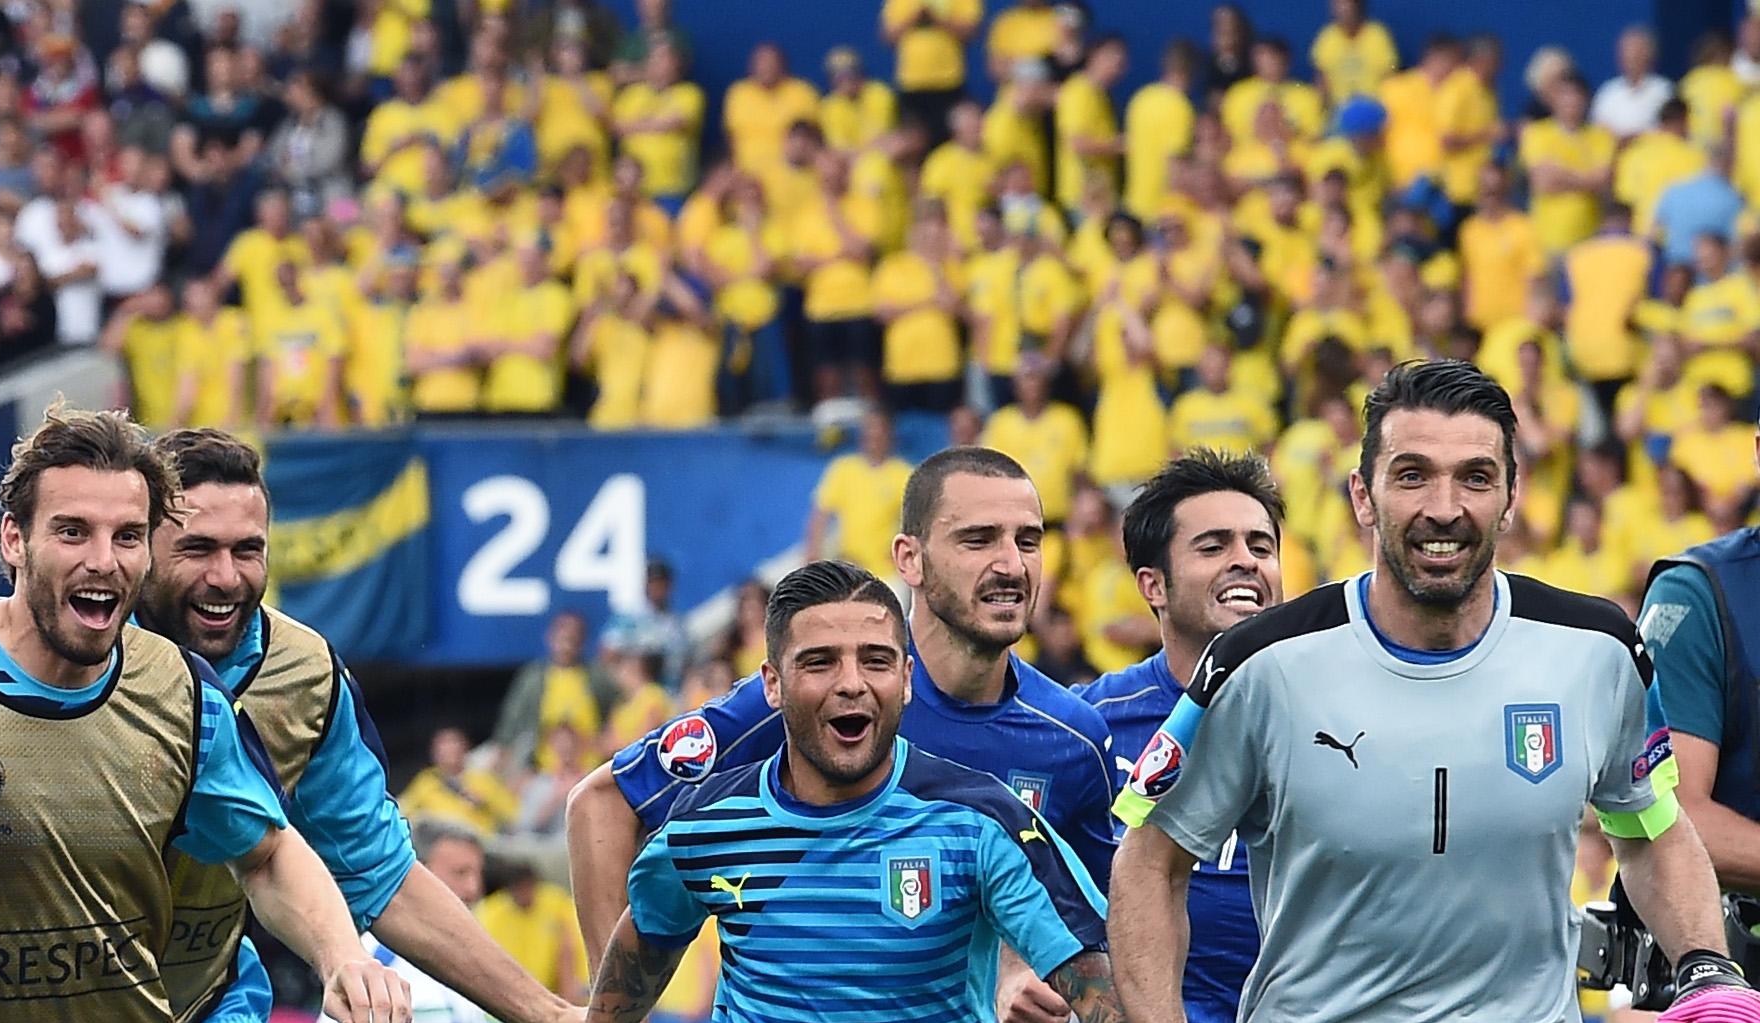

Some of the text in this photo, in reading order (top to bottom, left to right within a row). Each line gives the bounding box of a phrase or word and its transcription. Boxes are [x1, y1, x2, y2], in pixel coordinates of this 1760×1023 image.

[457, 473, 647, 617] 24
[1517, 715, 1549, 724] ITALIA
[1433, 767, 1448, 855] 1
[892, 860, 927, 870] ITALIA
